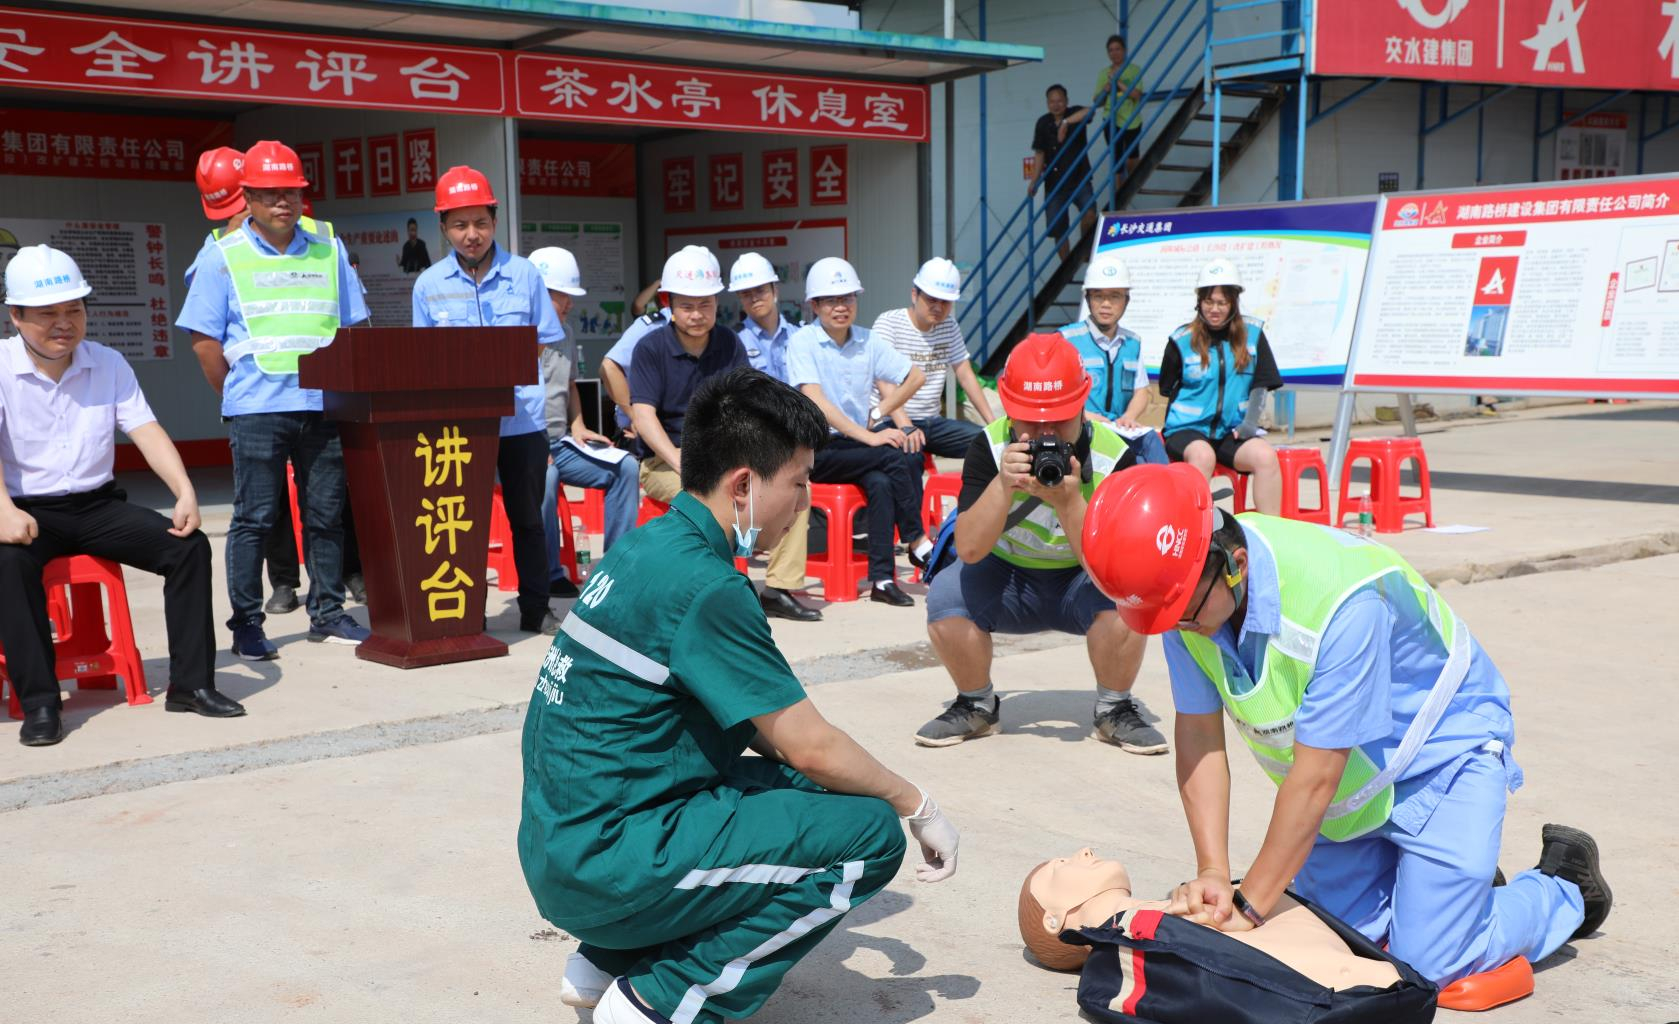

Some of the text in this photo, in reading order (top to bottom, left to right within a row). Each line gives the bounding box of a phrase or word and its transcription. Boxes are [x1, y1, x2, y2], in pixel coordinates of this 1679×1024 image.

[1385, 35, 1473, 67] 交水建集团
[540, 66, 910, 132] 茶水亭 休息室
[1, 130, 184, 160] 集团有限责任公司
[668, 155, 844, 206] 牢记安全
[1456, 192, 1670, 220] 湖南路桥建设集团有限责任公司简介
[1120, 221, 1172, 234] 长沙交通集团
[34, 274, 71, 289] 湖南路桥
[145, 224, 169, 358] 警钟长鸣 杜绝违章
[1023, 380, 1064, 392] 湖南路桥
[415, 425, 475, 622] 讲评台
[579, 570, 615, 609] 120
